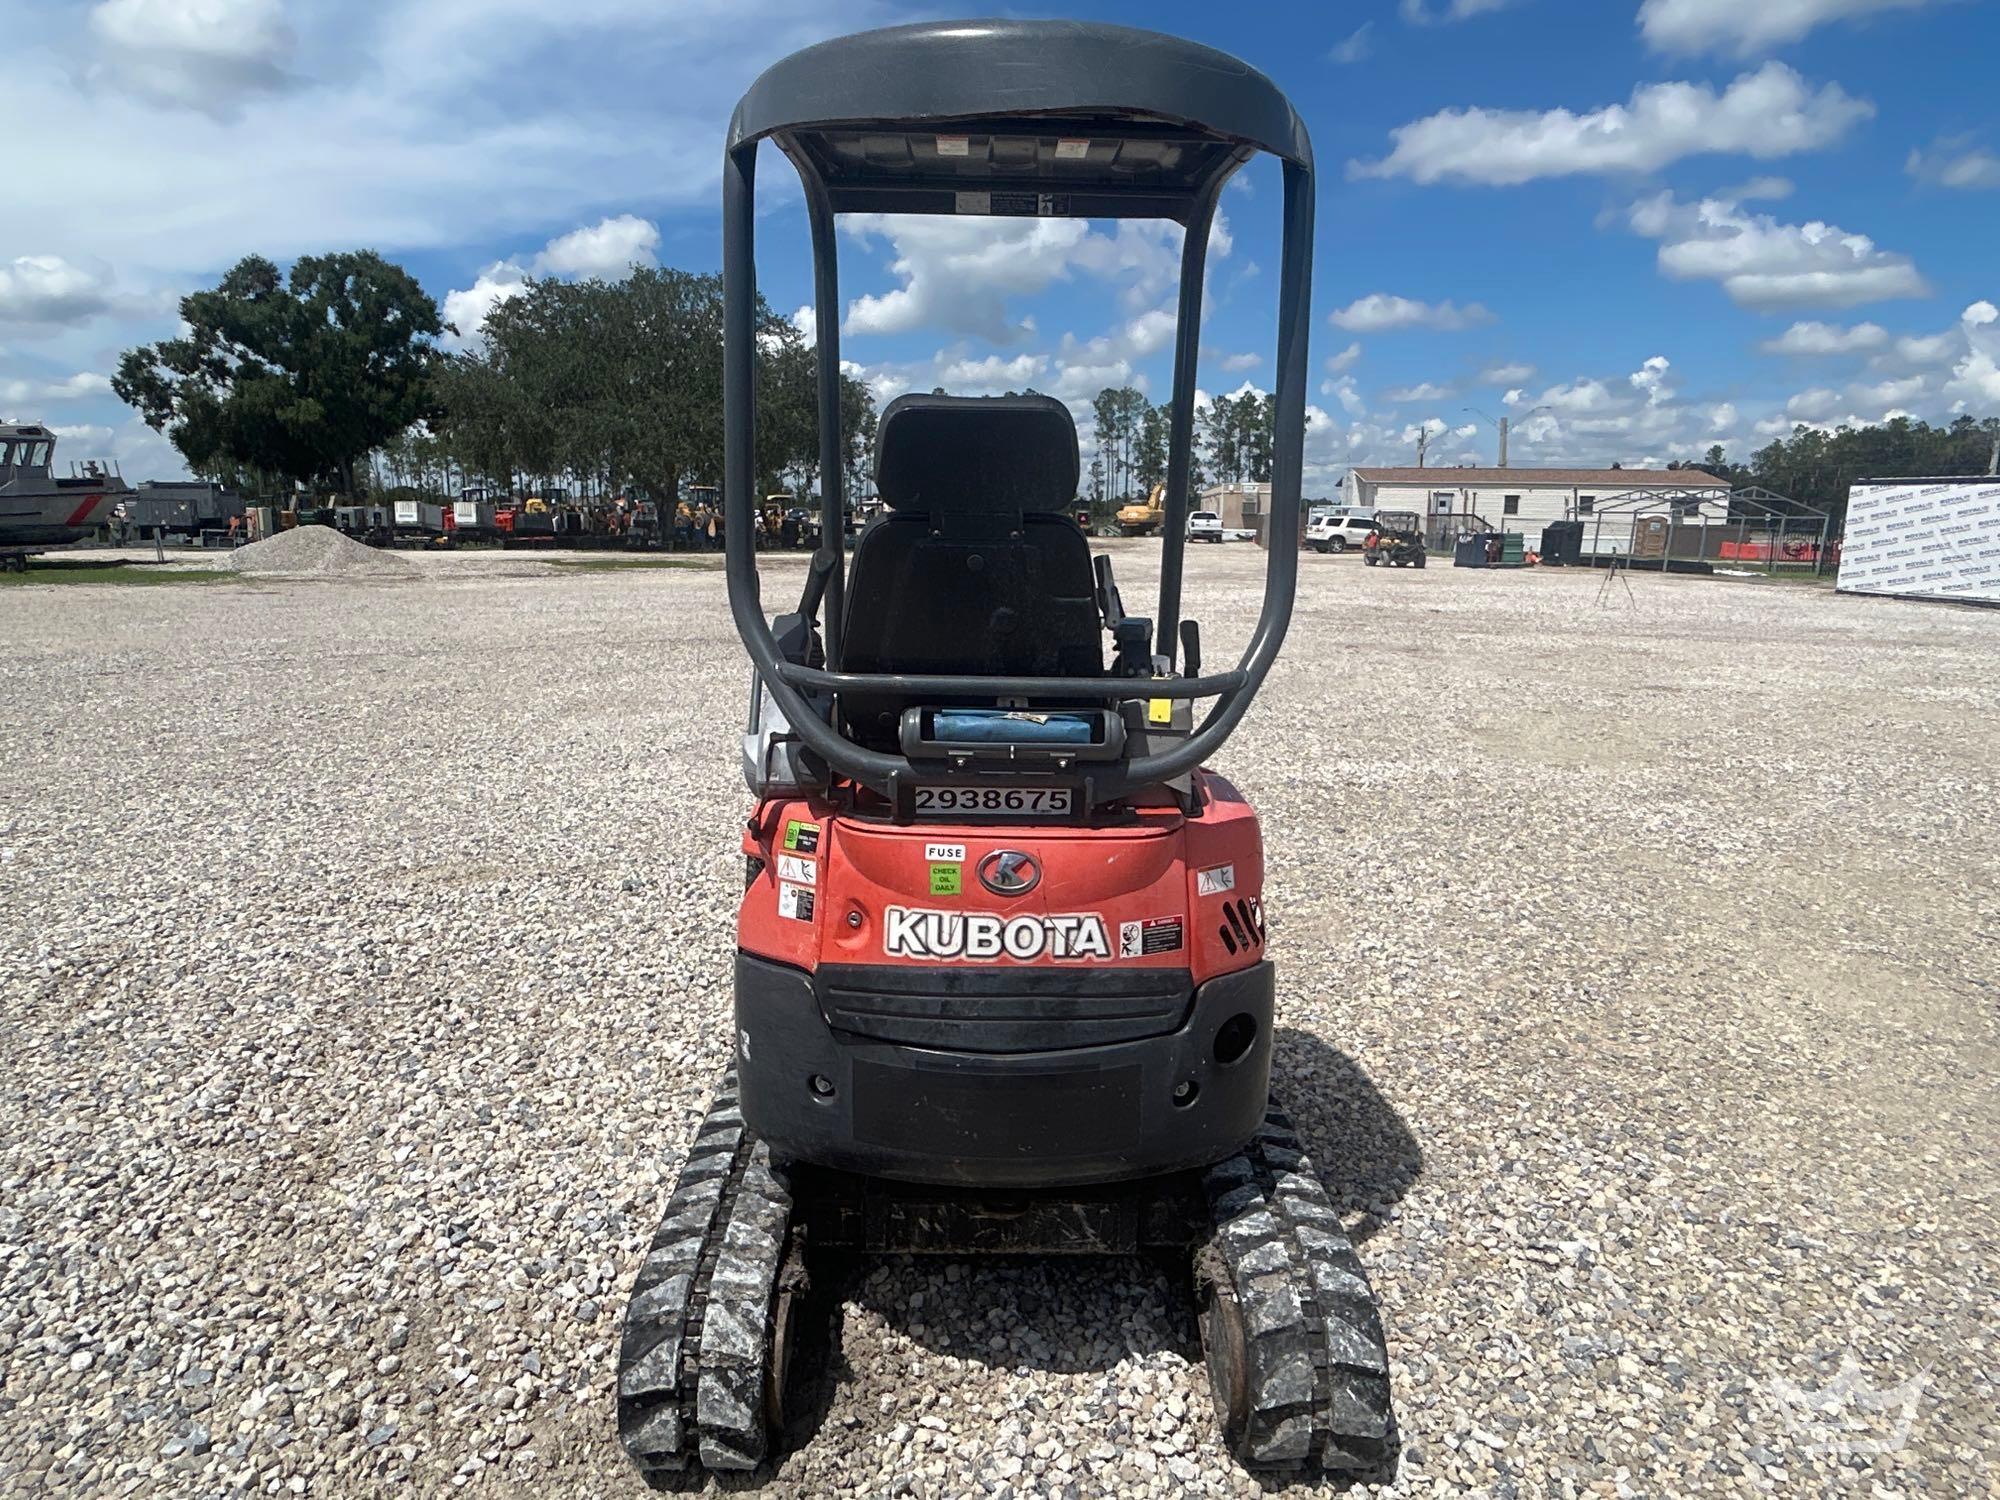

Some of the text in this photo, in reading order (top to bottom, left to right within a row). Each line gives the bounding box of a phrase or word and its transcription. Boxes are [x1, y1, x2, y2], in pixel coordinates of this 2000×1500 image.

[916, 789, 1068, 810] 2938675
[929, 847, 962, 858] FUSE
[933, 867, 958, 875] CHECK
[887, 908, 1111, 959] KUBOTA
